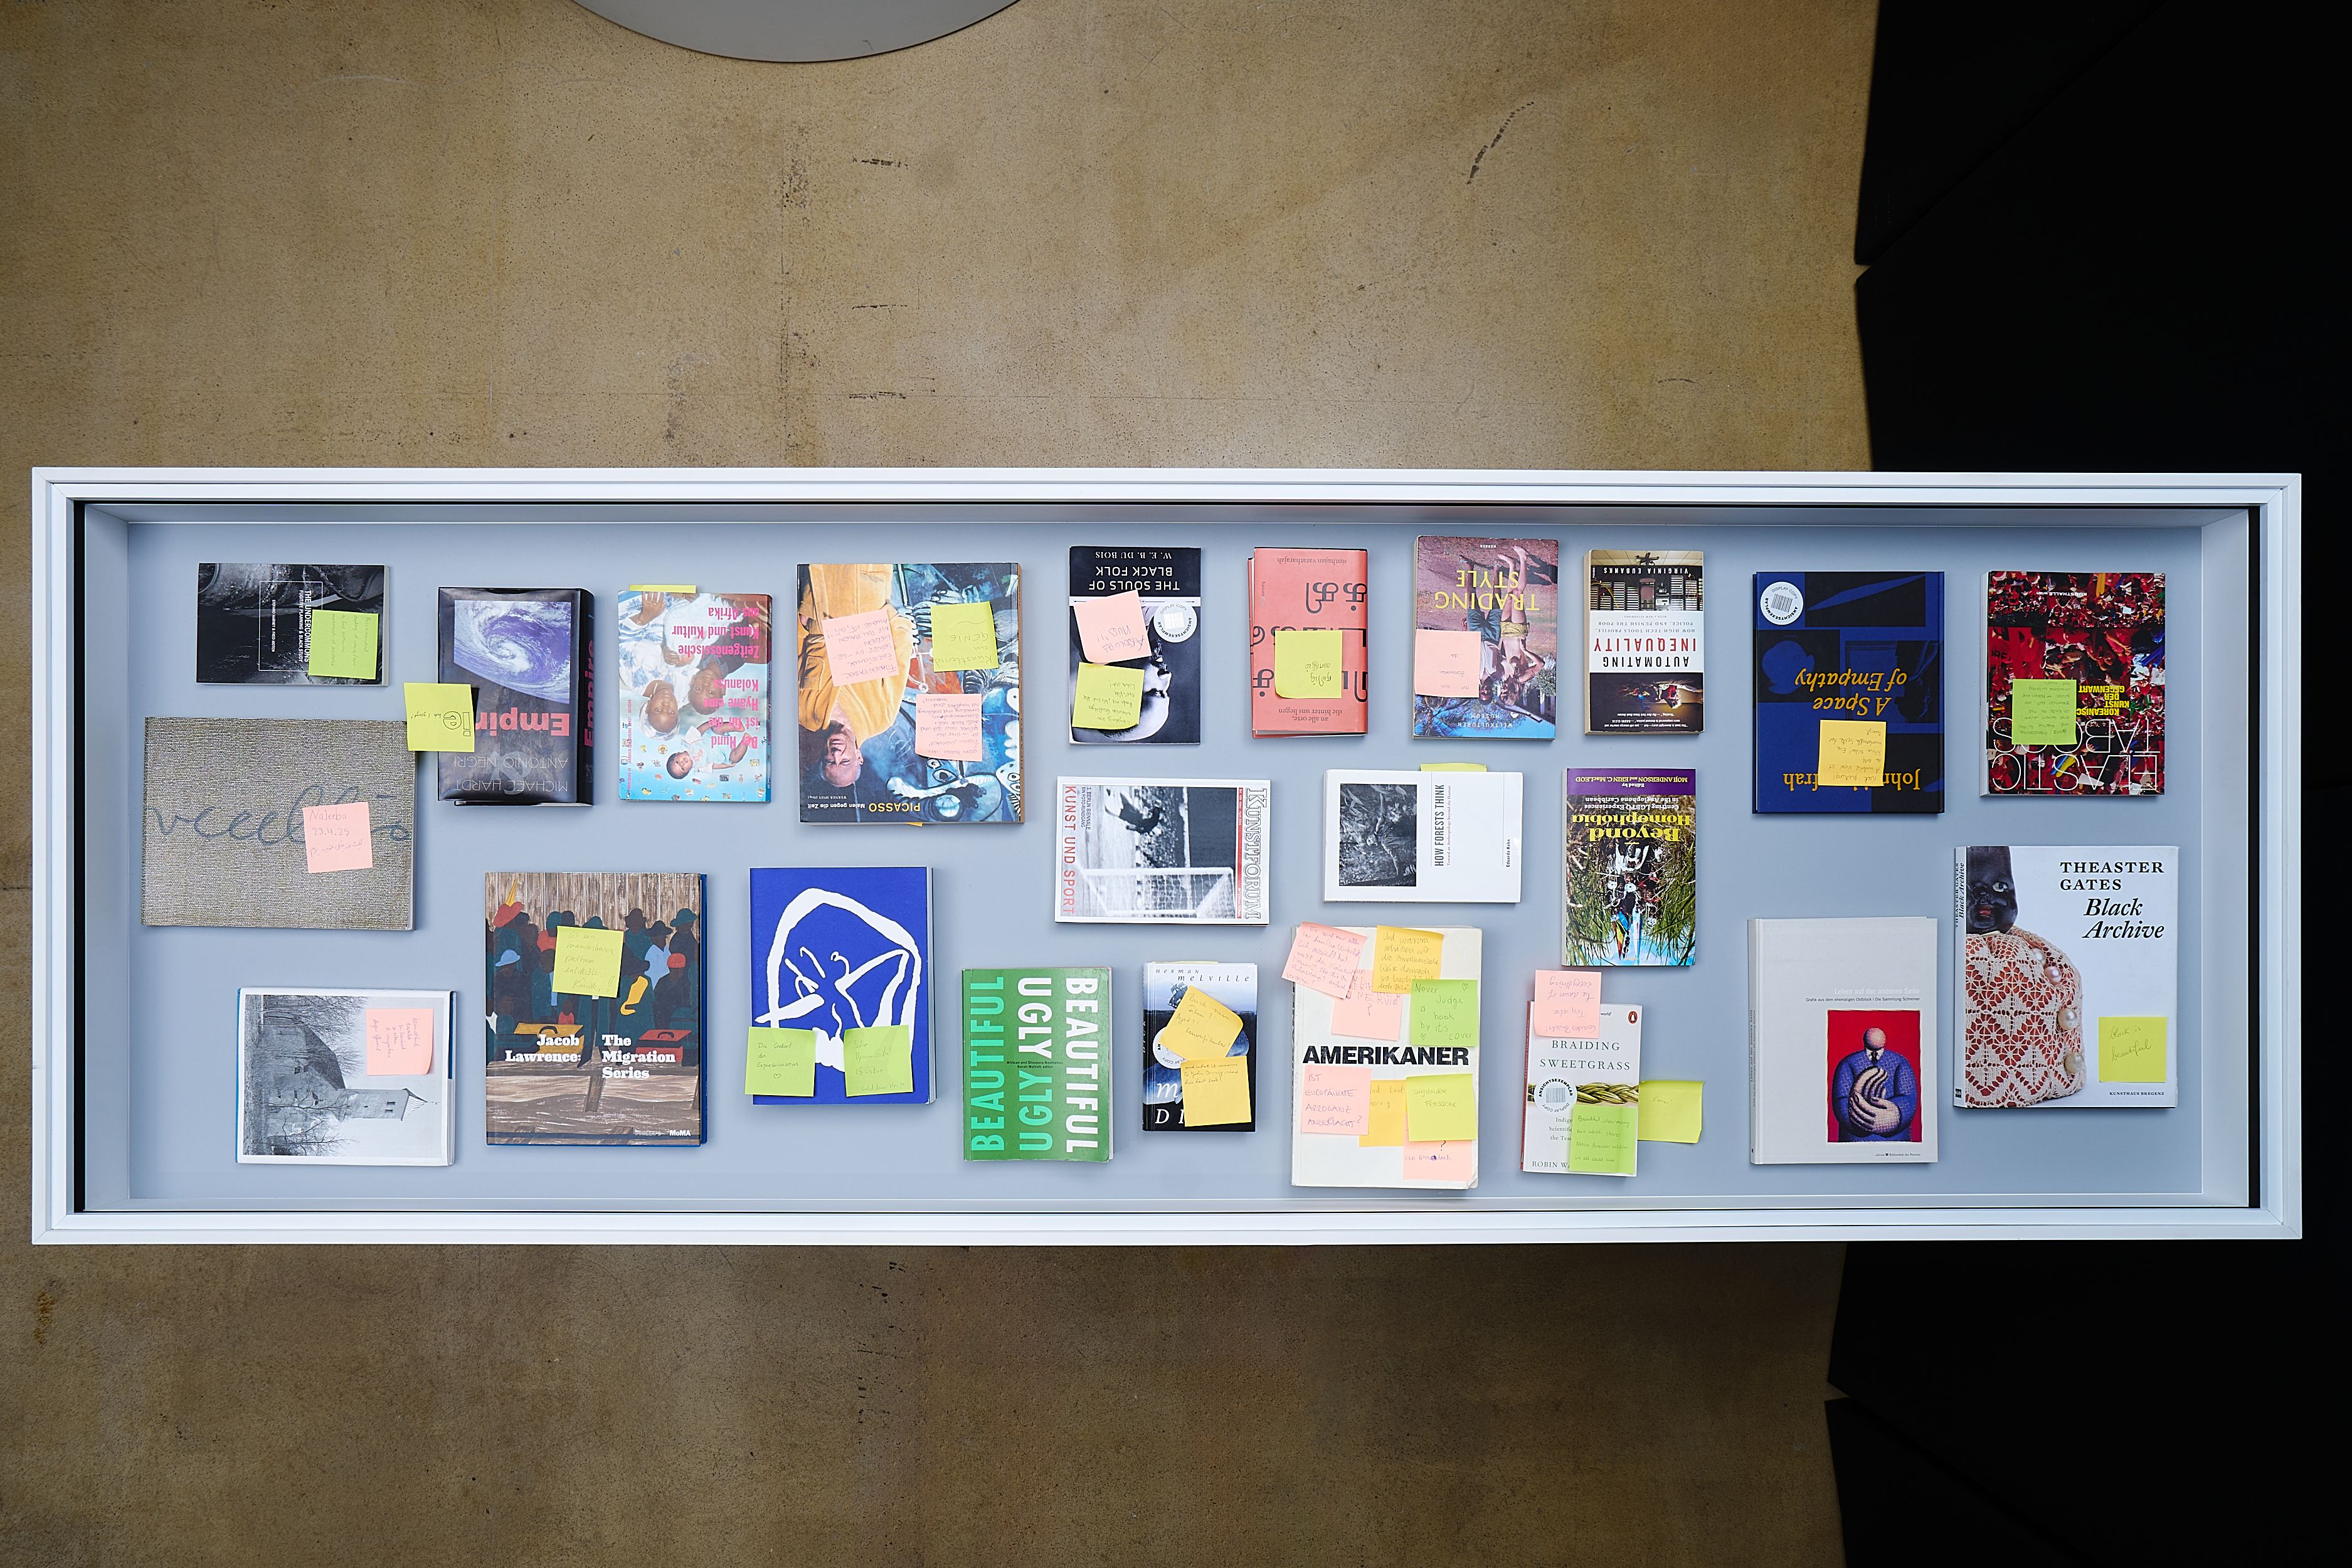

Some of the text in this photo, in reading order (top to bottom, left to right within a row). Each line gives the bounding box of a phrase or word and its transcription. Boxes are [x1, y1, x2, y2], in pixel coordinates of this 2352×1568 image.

[1276, 557, 1348, 566] sinthujan varatharajah
[1094, 566, 1173, 576] BLACK FOLK
[1602, 566, 1641, 575] EUBANKS
[1646, 566, 1689, 575] VIRGINIA
[1088, 580, 1180, 590] THE SOULS OF
[1456, 569, 1520, 589] STYLE
[1434, 591, 1540, 612] TRADING
[707, 607, 760, 620] aus Afrika
[1764, 597, 1798, 620] ANSICHTSEXEMPLAR
[304, 605, 312, 662] UNDERCOMMONS
[672, 625, 760, 639] Kunst und Kultur
[1157, 617, 1192, 638] ANSICHTSEXEMPLAR
[948, 631, 988, 642] GENIE
[677, 643, 760, 659] Zeitgenössische
[1593, 637, 1697, 652] INEQUALITY
[1602, 655, 1690, 668] AUTOMATING
[712, 678, 759, 692] Kolanuss
[1794, 668, 1907, 692] of Empathy
[2078, 685, 2126, 694] GEGENWART
[702, 696, 758, 711] Hyäne eine
[2104, 693, 2120, 701] DER
[1813, 693, 1892, 717] A Space
[2104, 700, 2130, 709] KUNST
[1278, 707, 1298, 717] liegen
[1311, 709, 1331, 717] hinter
[1331, 709, 1342, 717] die
[2077, 707, 2119, 716] KOREANISC
[475, 707, 570, 737] Empir
[744, 716, 759, 730] ist
[1291, 715, 1307, 723] orte,
[1308, 716, 1320, 724] alle
[1993, 717, 2161, 754] TABOS
[711, 735, 758, 750] Der Hund
[453, 756, 569, 768] ANTONIO NEGRI
[1991, 753, 2158, 792] ELASTIC
[453, 780, 568, 792] MICHAEL HARDT
[1621, 795, 1660, 803] Anglophone
[868, 802, 921, 812] PICASSO
[1434, 784, 1444, 866] HOW FORESTS THINK
[1571, 812, 1691, 827] Homophobia
[1587, 824, 1680, 842] Beyond
[1063, 786, 1077, 914] KUNST UND SPORT
[1244, 788, 1268, 919] KUNSTFORUM
[2059, 861, 2165, 874] THEASTER
[2060, 878, 2122, 891] GATES
[2084, 898, 2144, 916] Black
[2082, 920, 2164, 940] Archive
[1414, 982, 1438, 994] Never
[1436, 996, 1464, 1009] Judge
[1017, 977, 1052, 1059] UGLY
[1434, 1010, 1455, 1020] book
[1420, 1021, 1449, 1034] by it's
[2109, 1025, 2131, 1040] black
[537, 1034, 632, 1047] Jacob The
[1449, 1032, 1472, 1041] cover
[1552, 1040, 1621, 1051] BRAIDING
[2111, 1038, 2153, 1062] beautiful
[505, 1050, 676, 1066] Lawrence: Migration
[1302, 1045, 1470, 1066] AMERIKANER
[970, 976, 1005, 1152] BEAUTIFUL
[1065, 977, 1098, 1153] BEAUTIFUL
[1540, 1059, 1631, 1071] SWEETGRASS
[601, 1067, 650, 1080] Series
[1308, 1073, 1322, 1082] IST
[1538, 1078, 1573, 1098] ANSICHTSEXEMPLAR
[1018, 1069, 1053, 1152] UGLY
[1532, 1160, 1559, 1168] ROBIN
